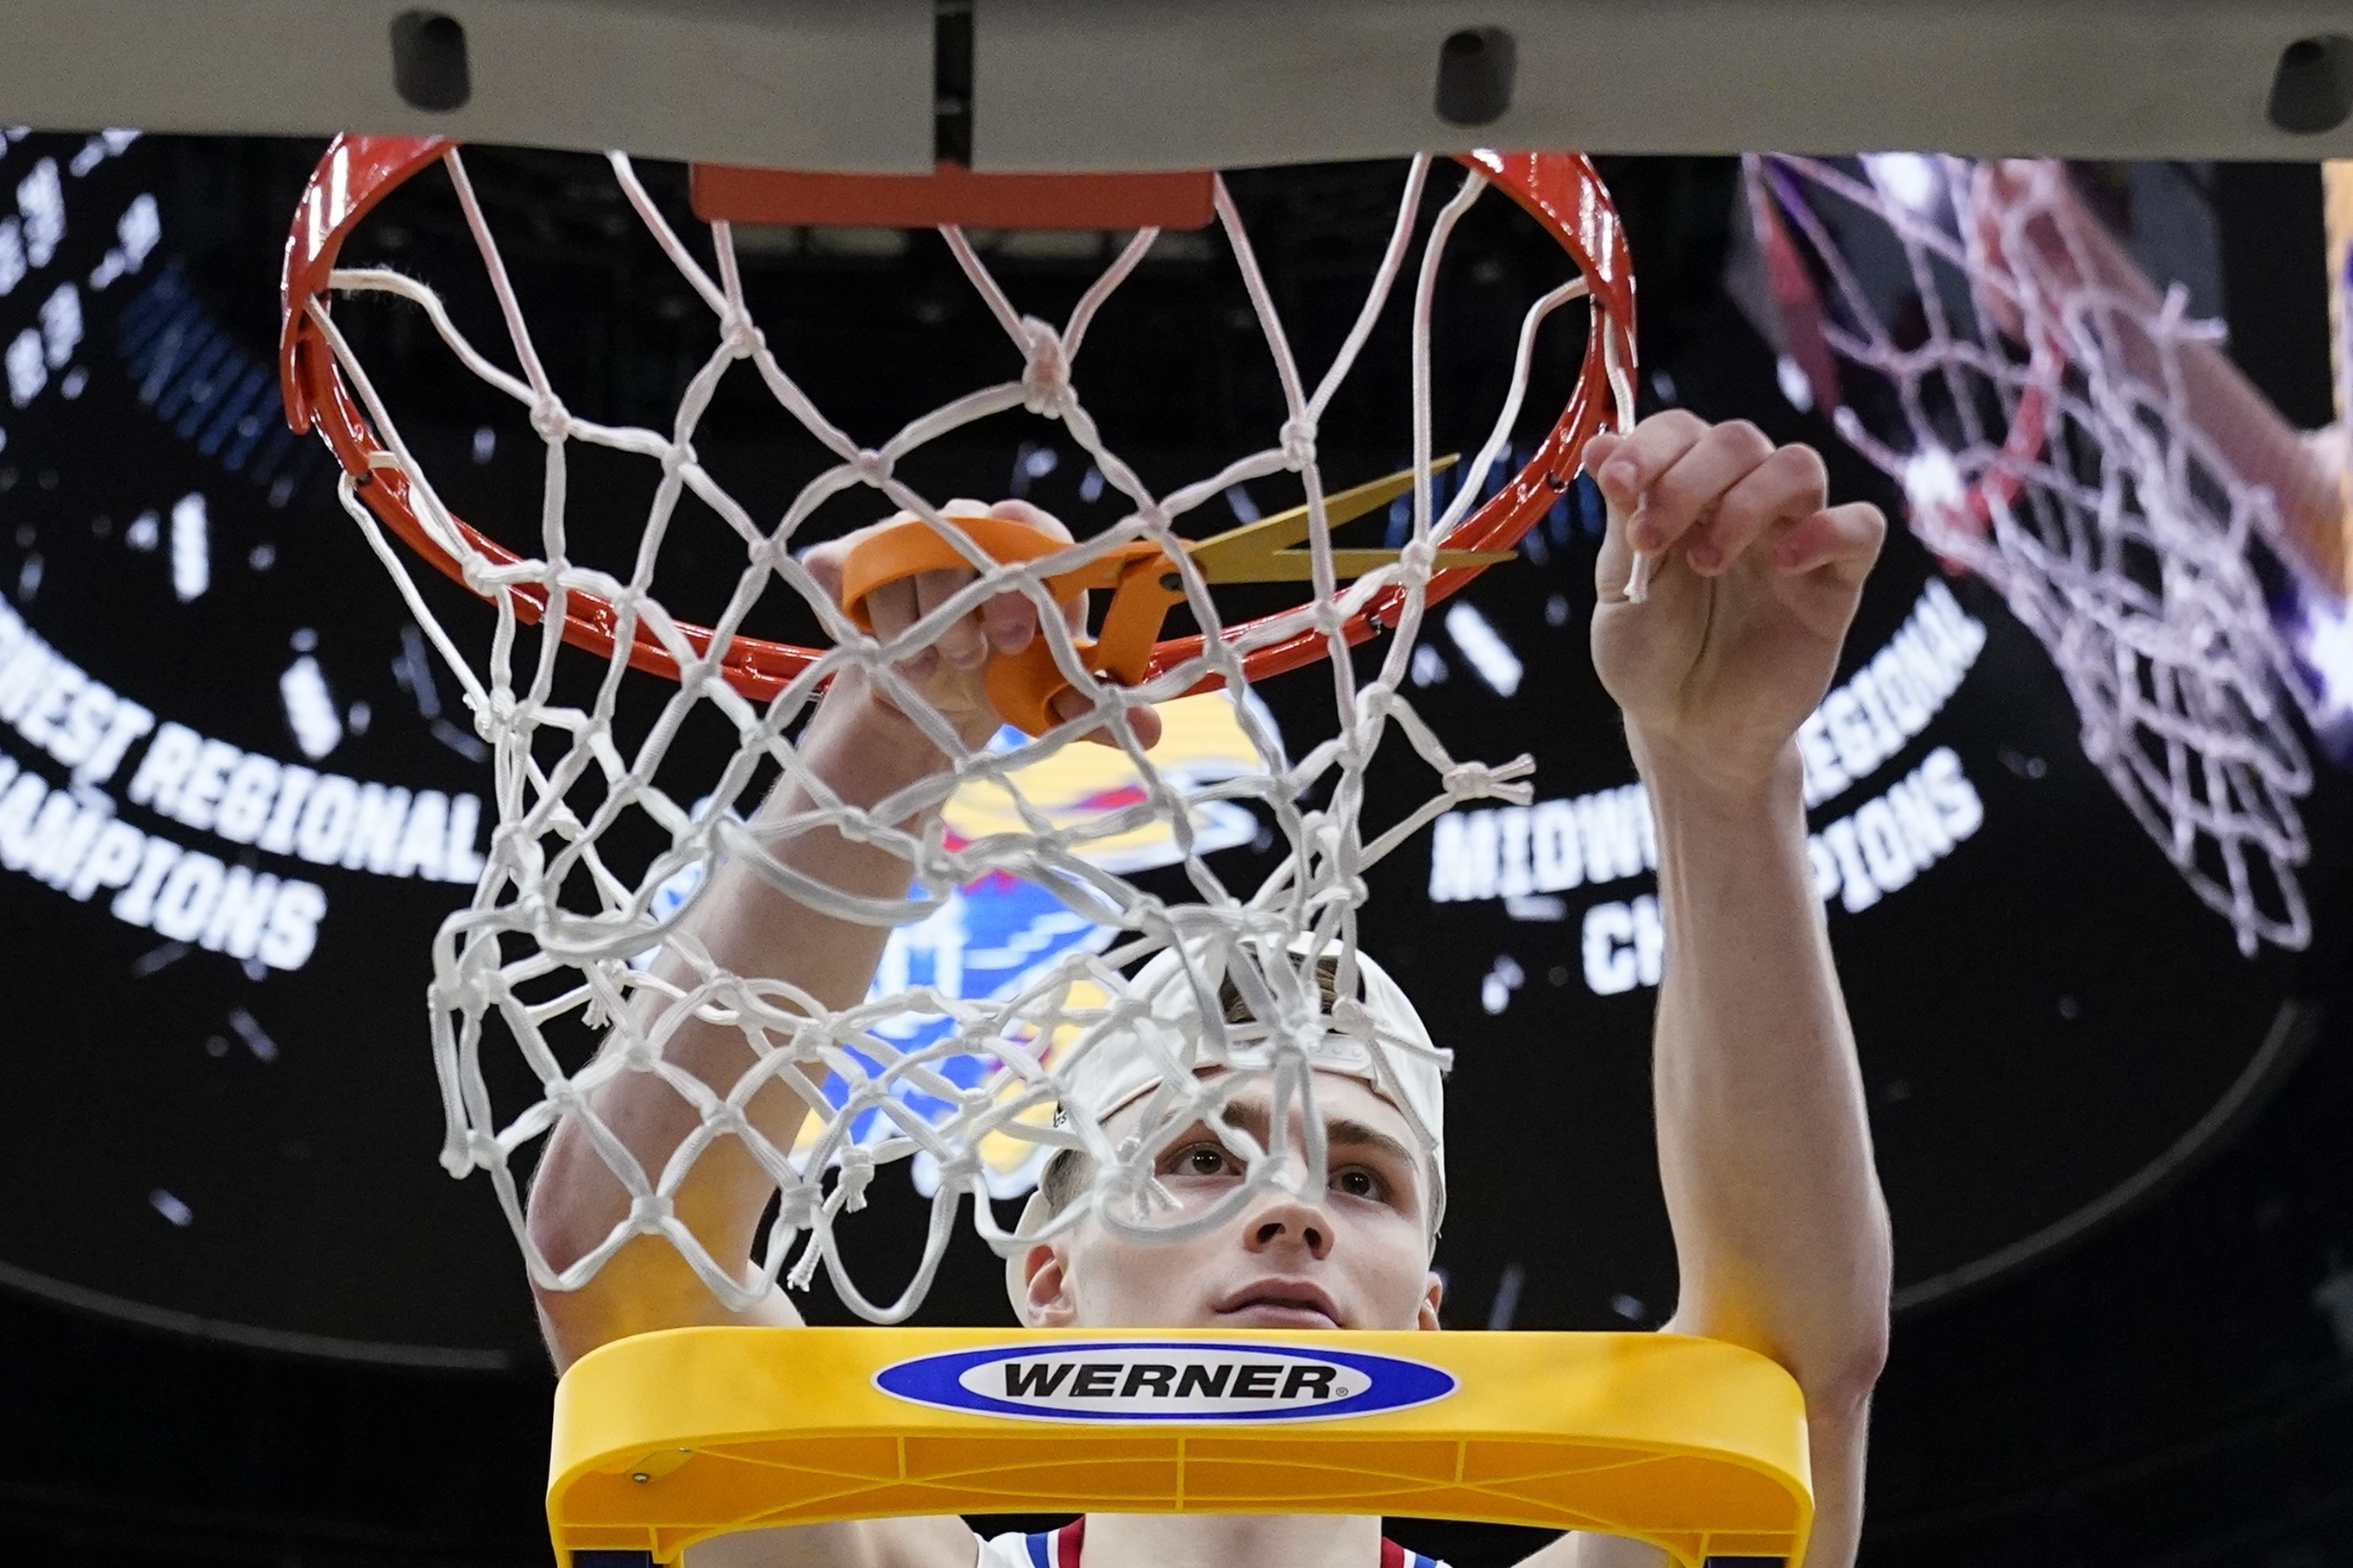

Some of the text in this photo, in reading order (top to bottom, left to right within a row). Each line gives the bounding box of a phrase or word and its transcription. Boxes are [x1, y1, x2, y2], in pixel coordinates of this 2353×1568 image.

[1799, 577, 1987, 808] EGIONAL
[0, 752, 327, 971] AMPIONS
[129, 721, 485, 884] REGIONAL
